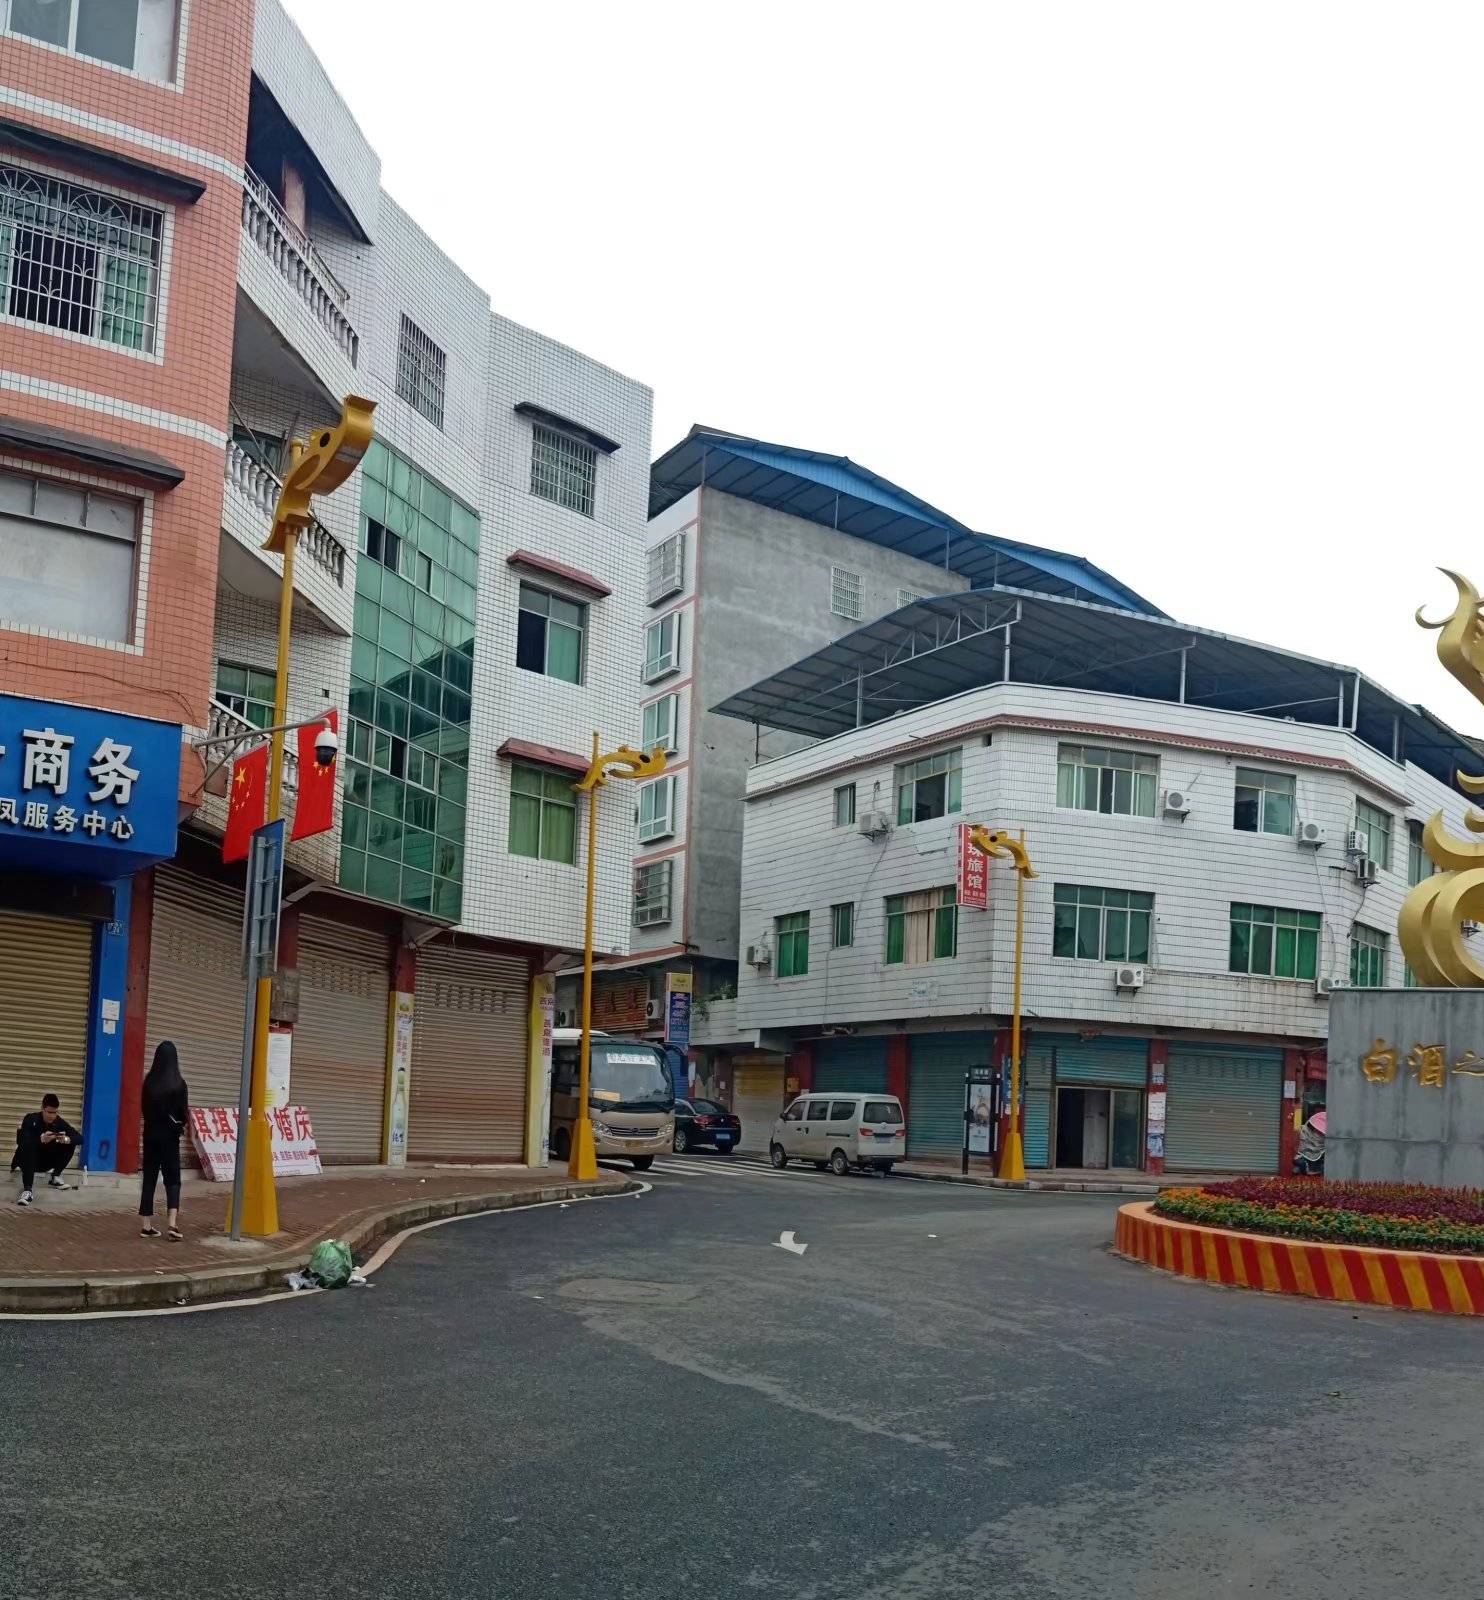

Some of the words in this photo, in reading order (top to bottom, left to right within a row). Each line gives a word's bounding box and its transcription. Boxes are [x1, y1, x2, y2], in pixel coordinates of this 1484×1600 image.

[0, 728, 140, 805] 商务
[0, 797, 135, 840] 凤服务中心
[192, 1105, 315, 1143] 琪琪婚庆
